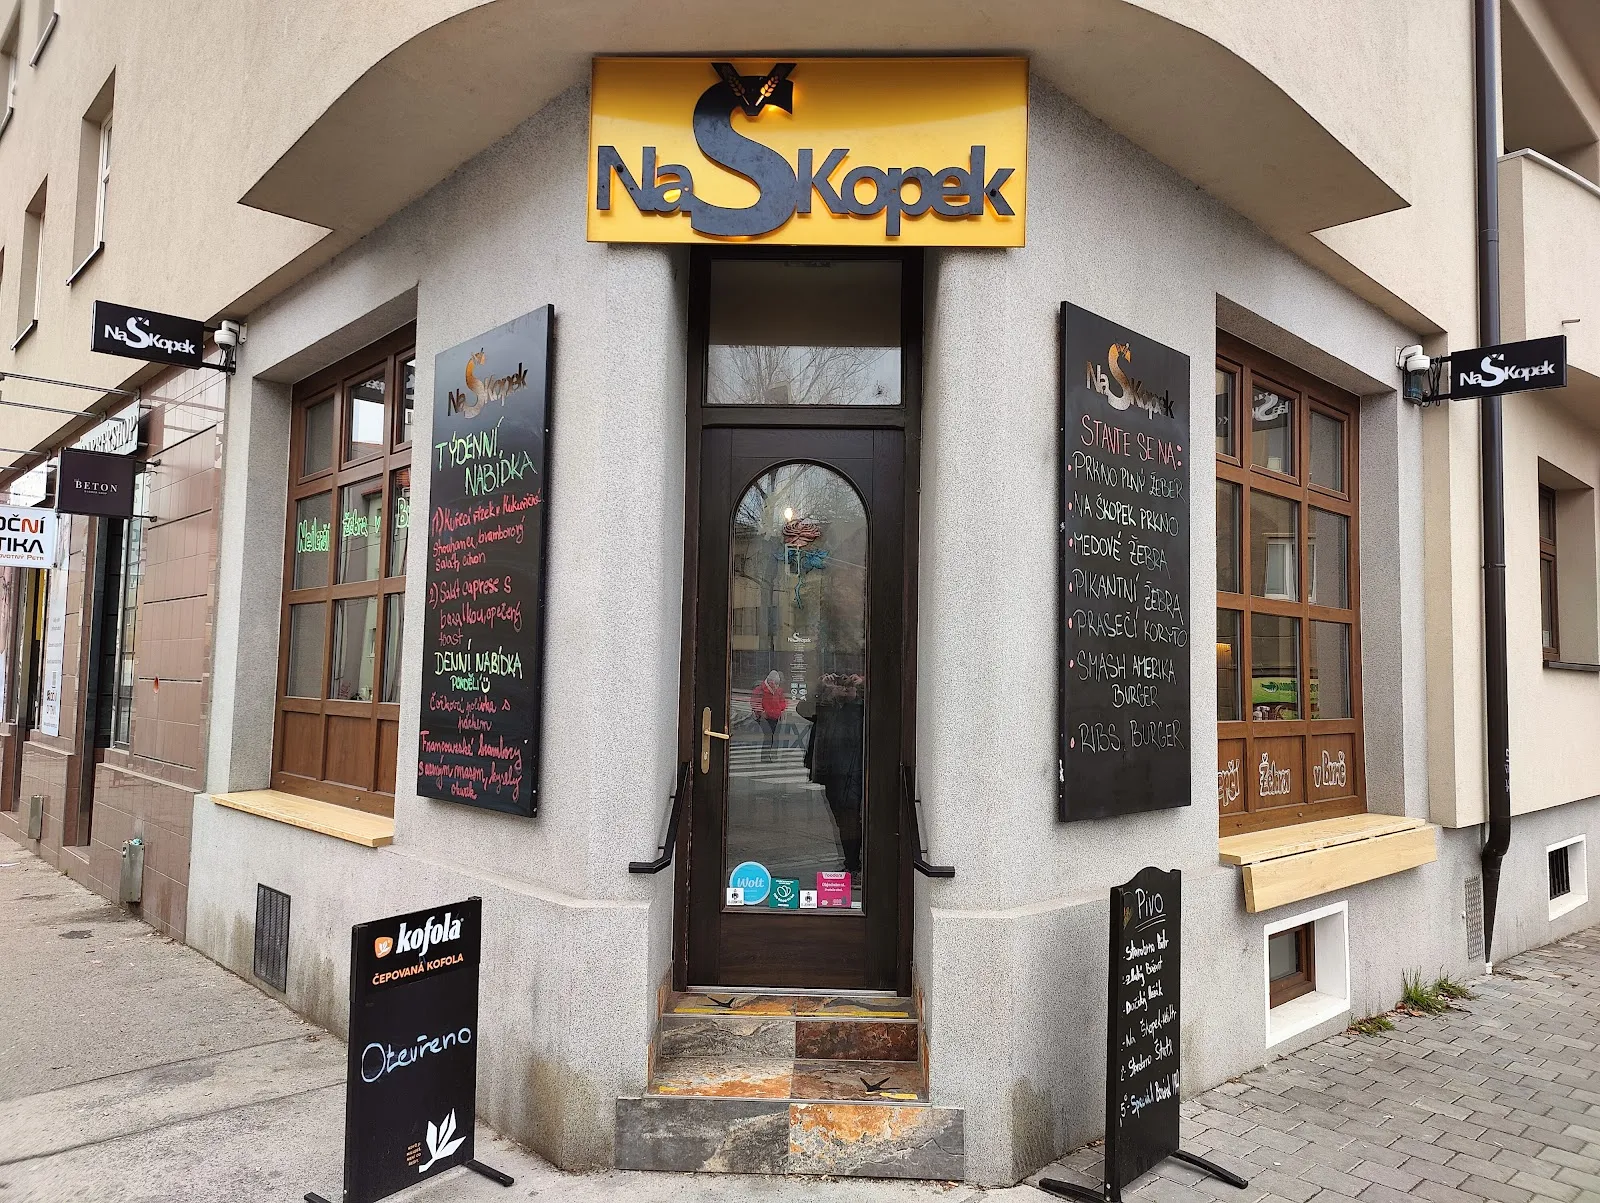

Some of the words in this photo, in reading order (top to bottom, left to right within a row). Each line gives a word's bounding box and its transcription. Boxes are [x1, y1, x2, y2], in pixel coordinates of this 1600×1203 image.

[1136, 432, 1155, 462] SE
[75, 480, 118, 493] BETON
[465, 450, 538, 496] NABÍDKA
[1073, 490, 1093, 518] NA
[1073, 530, 1122, 562] MEDOVÉ
[1071, 568, 1140, 604] PIKANTNÍ
[1072, 605, 1140, 639] PRASEČÍ
[434, 638, 472, 675] DENNÍ
[475, 645, 523, 680] NABÍDKA
[1076, 649, 1127, 683] SMASH
[737, 876, 765, 888] Wolt
[1135, 887, 1164, 920] Pivo
[396, 912, 461, 957] kofola
[372, 961, 425, 986] ČEPOVANÁ
[426, 952, 464, 972] KOFOLA
[360, 1027, 472, 1083] Otevřeno
